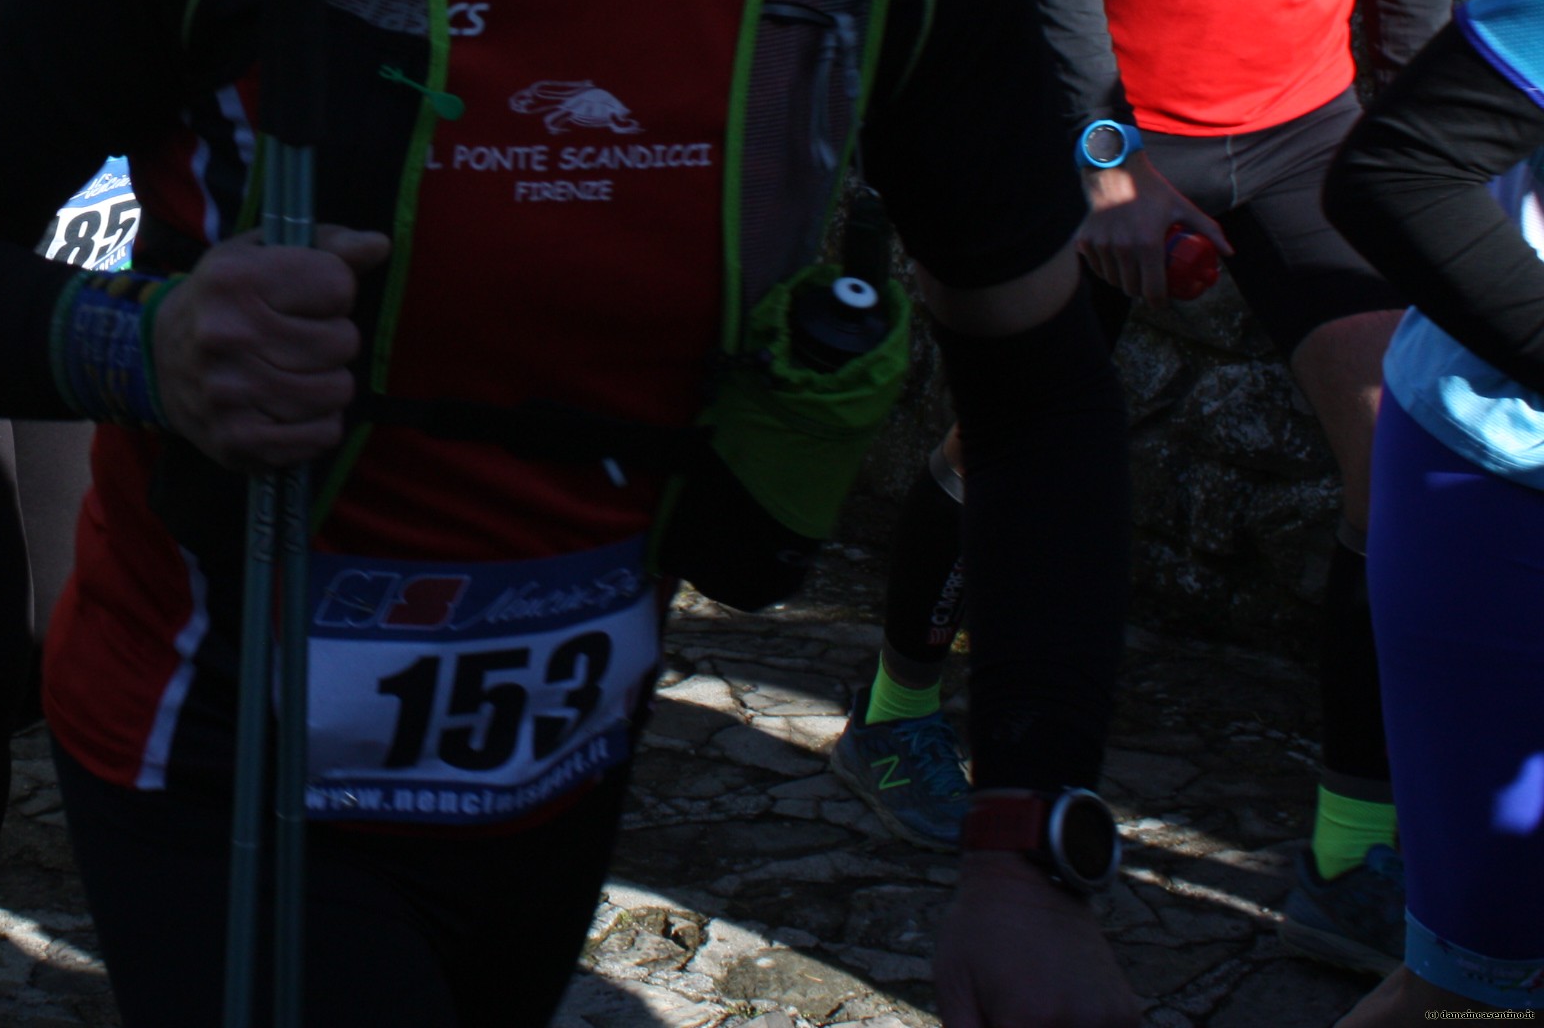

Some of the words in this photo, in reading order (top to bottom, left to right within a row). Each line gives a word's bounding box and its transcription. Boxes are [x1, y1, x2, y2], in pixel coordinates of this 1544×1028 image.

[452, 144, 550, 171] PONTE
[558, 143, 713, 170] SCANDICCI
[514, 179, 615, 203] FIRENZE
[377, 631, 612, 772] 153
